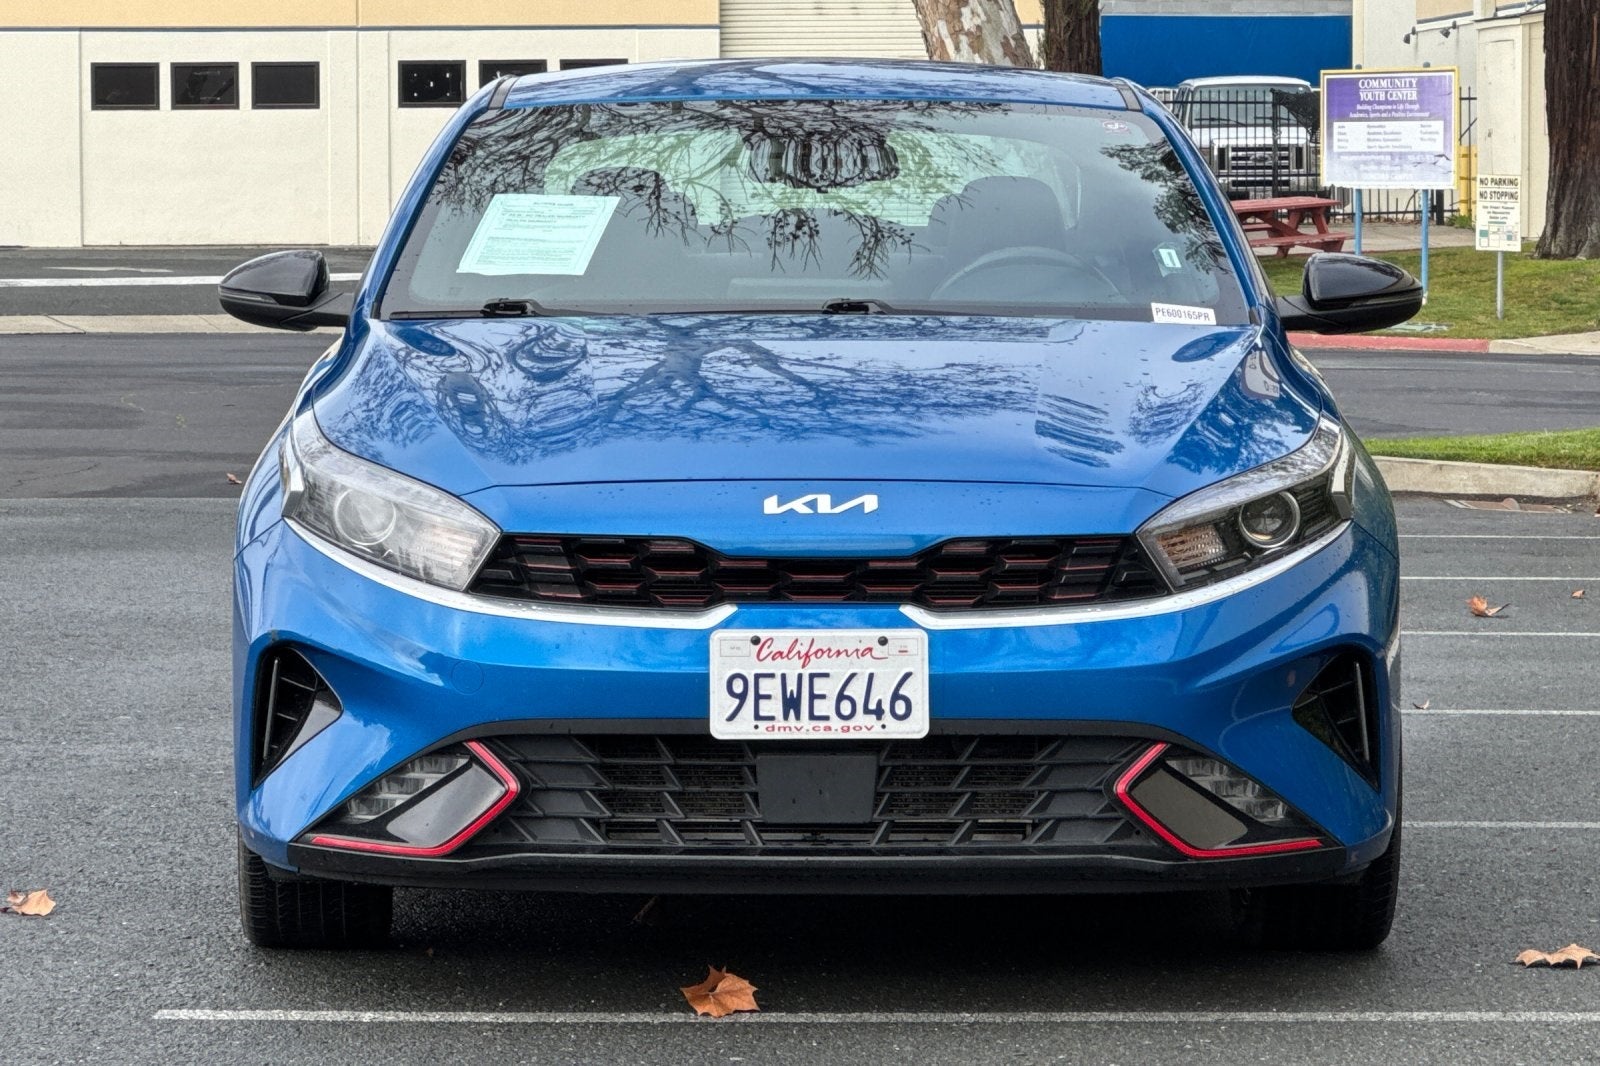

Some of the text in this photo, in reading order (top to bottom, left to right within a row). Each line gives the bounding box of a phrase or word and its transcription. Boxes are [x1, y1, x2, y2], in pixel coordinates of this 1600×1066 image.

[1358, 78, 1418, 89] COMMUNITY
[1359, 90, 1418, 102] YOUTH CENTER
[1479, 177, 1519, 187] NO PARKING
[1479, 191, 1519, 200] NO STOPPING
[1155, 307, 1211, 321] PE600165PR
[763, 494, 879, 514] KIA
[756, 637, 889, 669] California
[725, 671, 914, 722] 9EWE646
[765, 723, 875, 733] dmv.ca.gov
